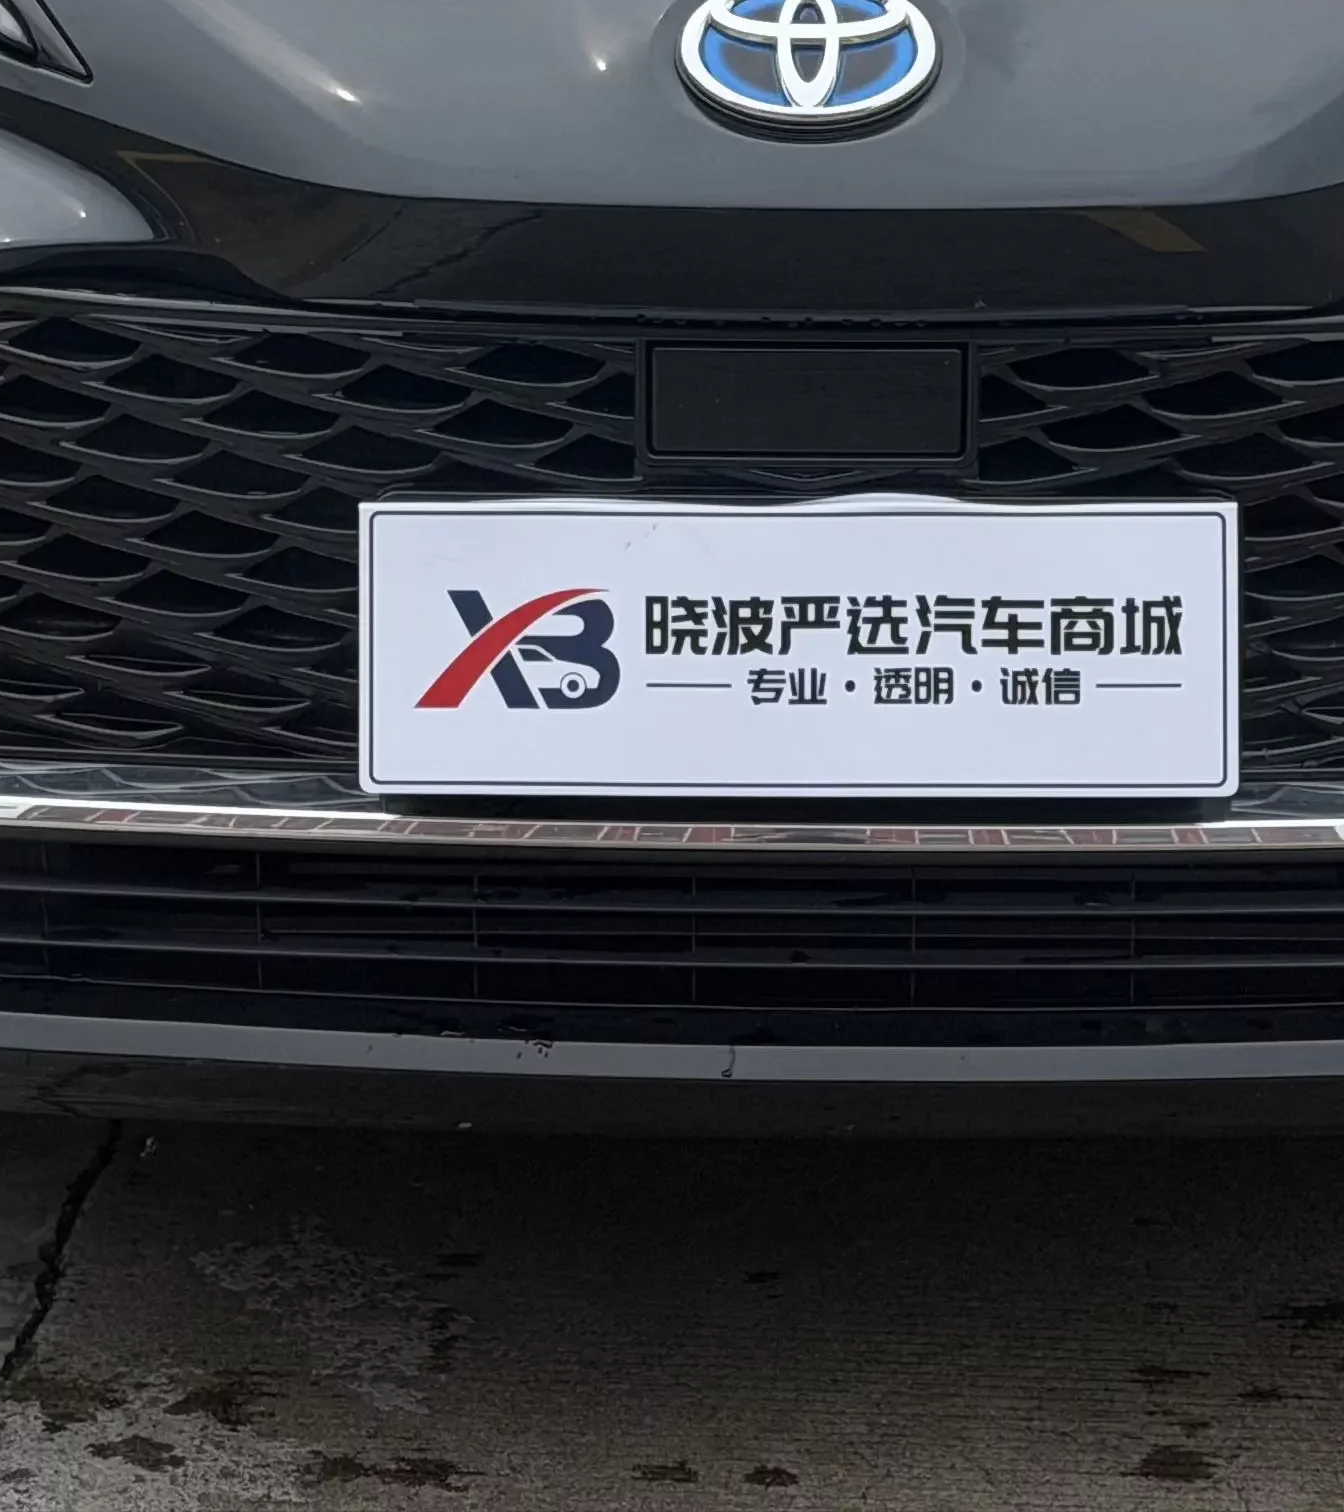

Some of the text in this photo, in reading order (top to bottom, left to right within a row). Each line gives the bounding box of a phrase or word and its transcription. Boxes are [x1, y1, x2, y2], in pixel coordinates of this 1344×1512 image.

[644, 594, 1184, 656] 晓波严选汽车商城
